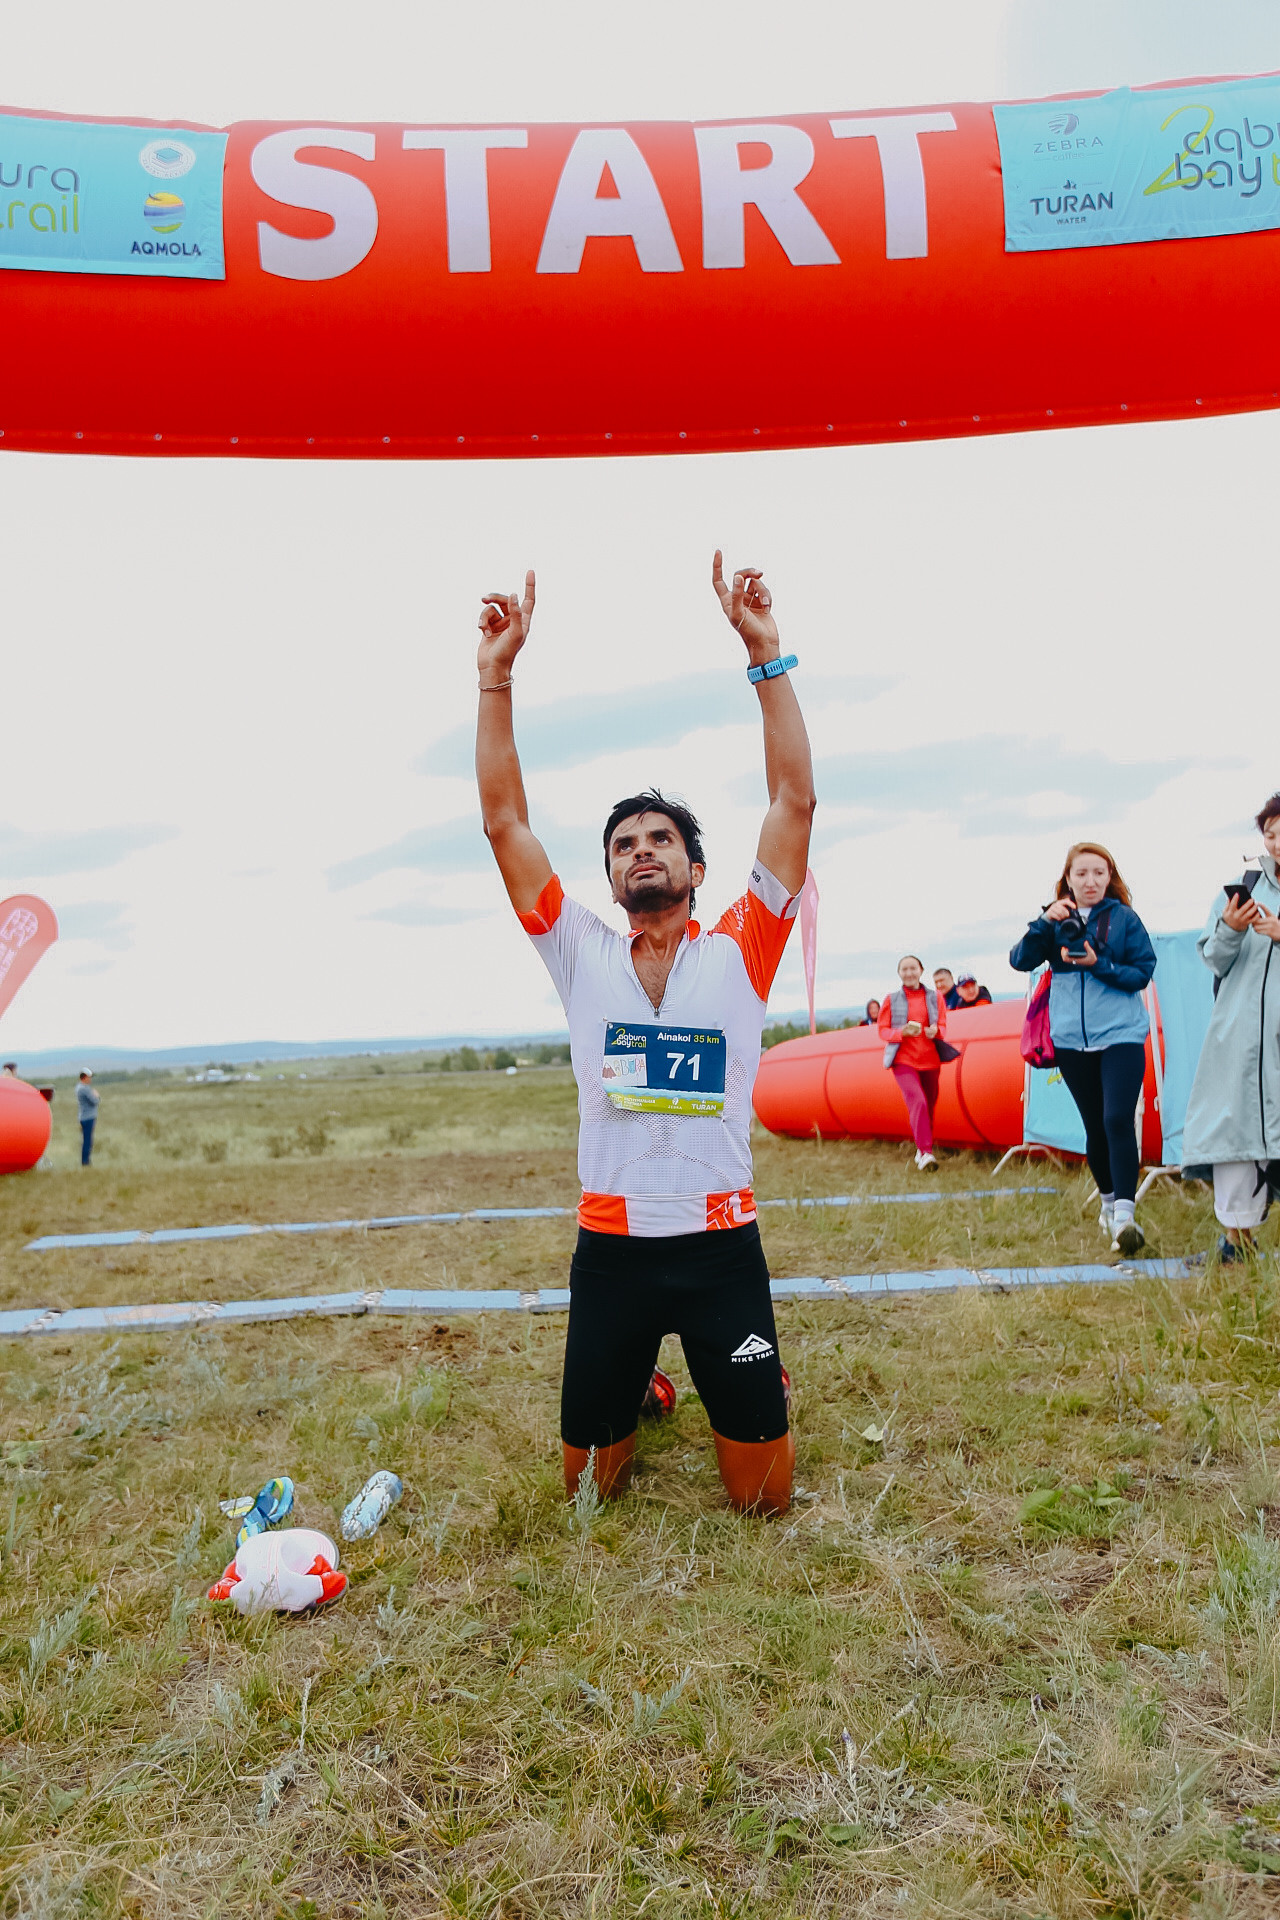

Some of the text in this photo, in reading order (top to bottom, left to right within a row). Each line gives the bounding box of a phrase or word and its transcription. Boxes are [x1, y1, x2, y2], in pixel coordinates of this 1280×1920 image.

[1033, 136, 1104, 154] ZEBRA
[250, 111, 957, 281] START
[1029, 191, 1114, 216] TURAN
[0, 194, 79, 233] rail
[1056, 216, 1087, 225] WATER
[130, 240, 202, 256] AQMOLA
[656, 1032, 720, 1044] Ainakol 35 km
[666, 1052, 701, 1081] 71
[691, 1103, 717, 1111] TURAN
[756, 1350, 775, 1360] TRAIL
